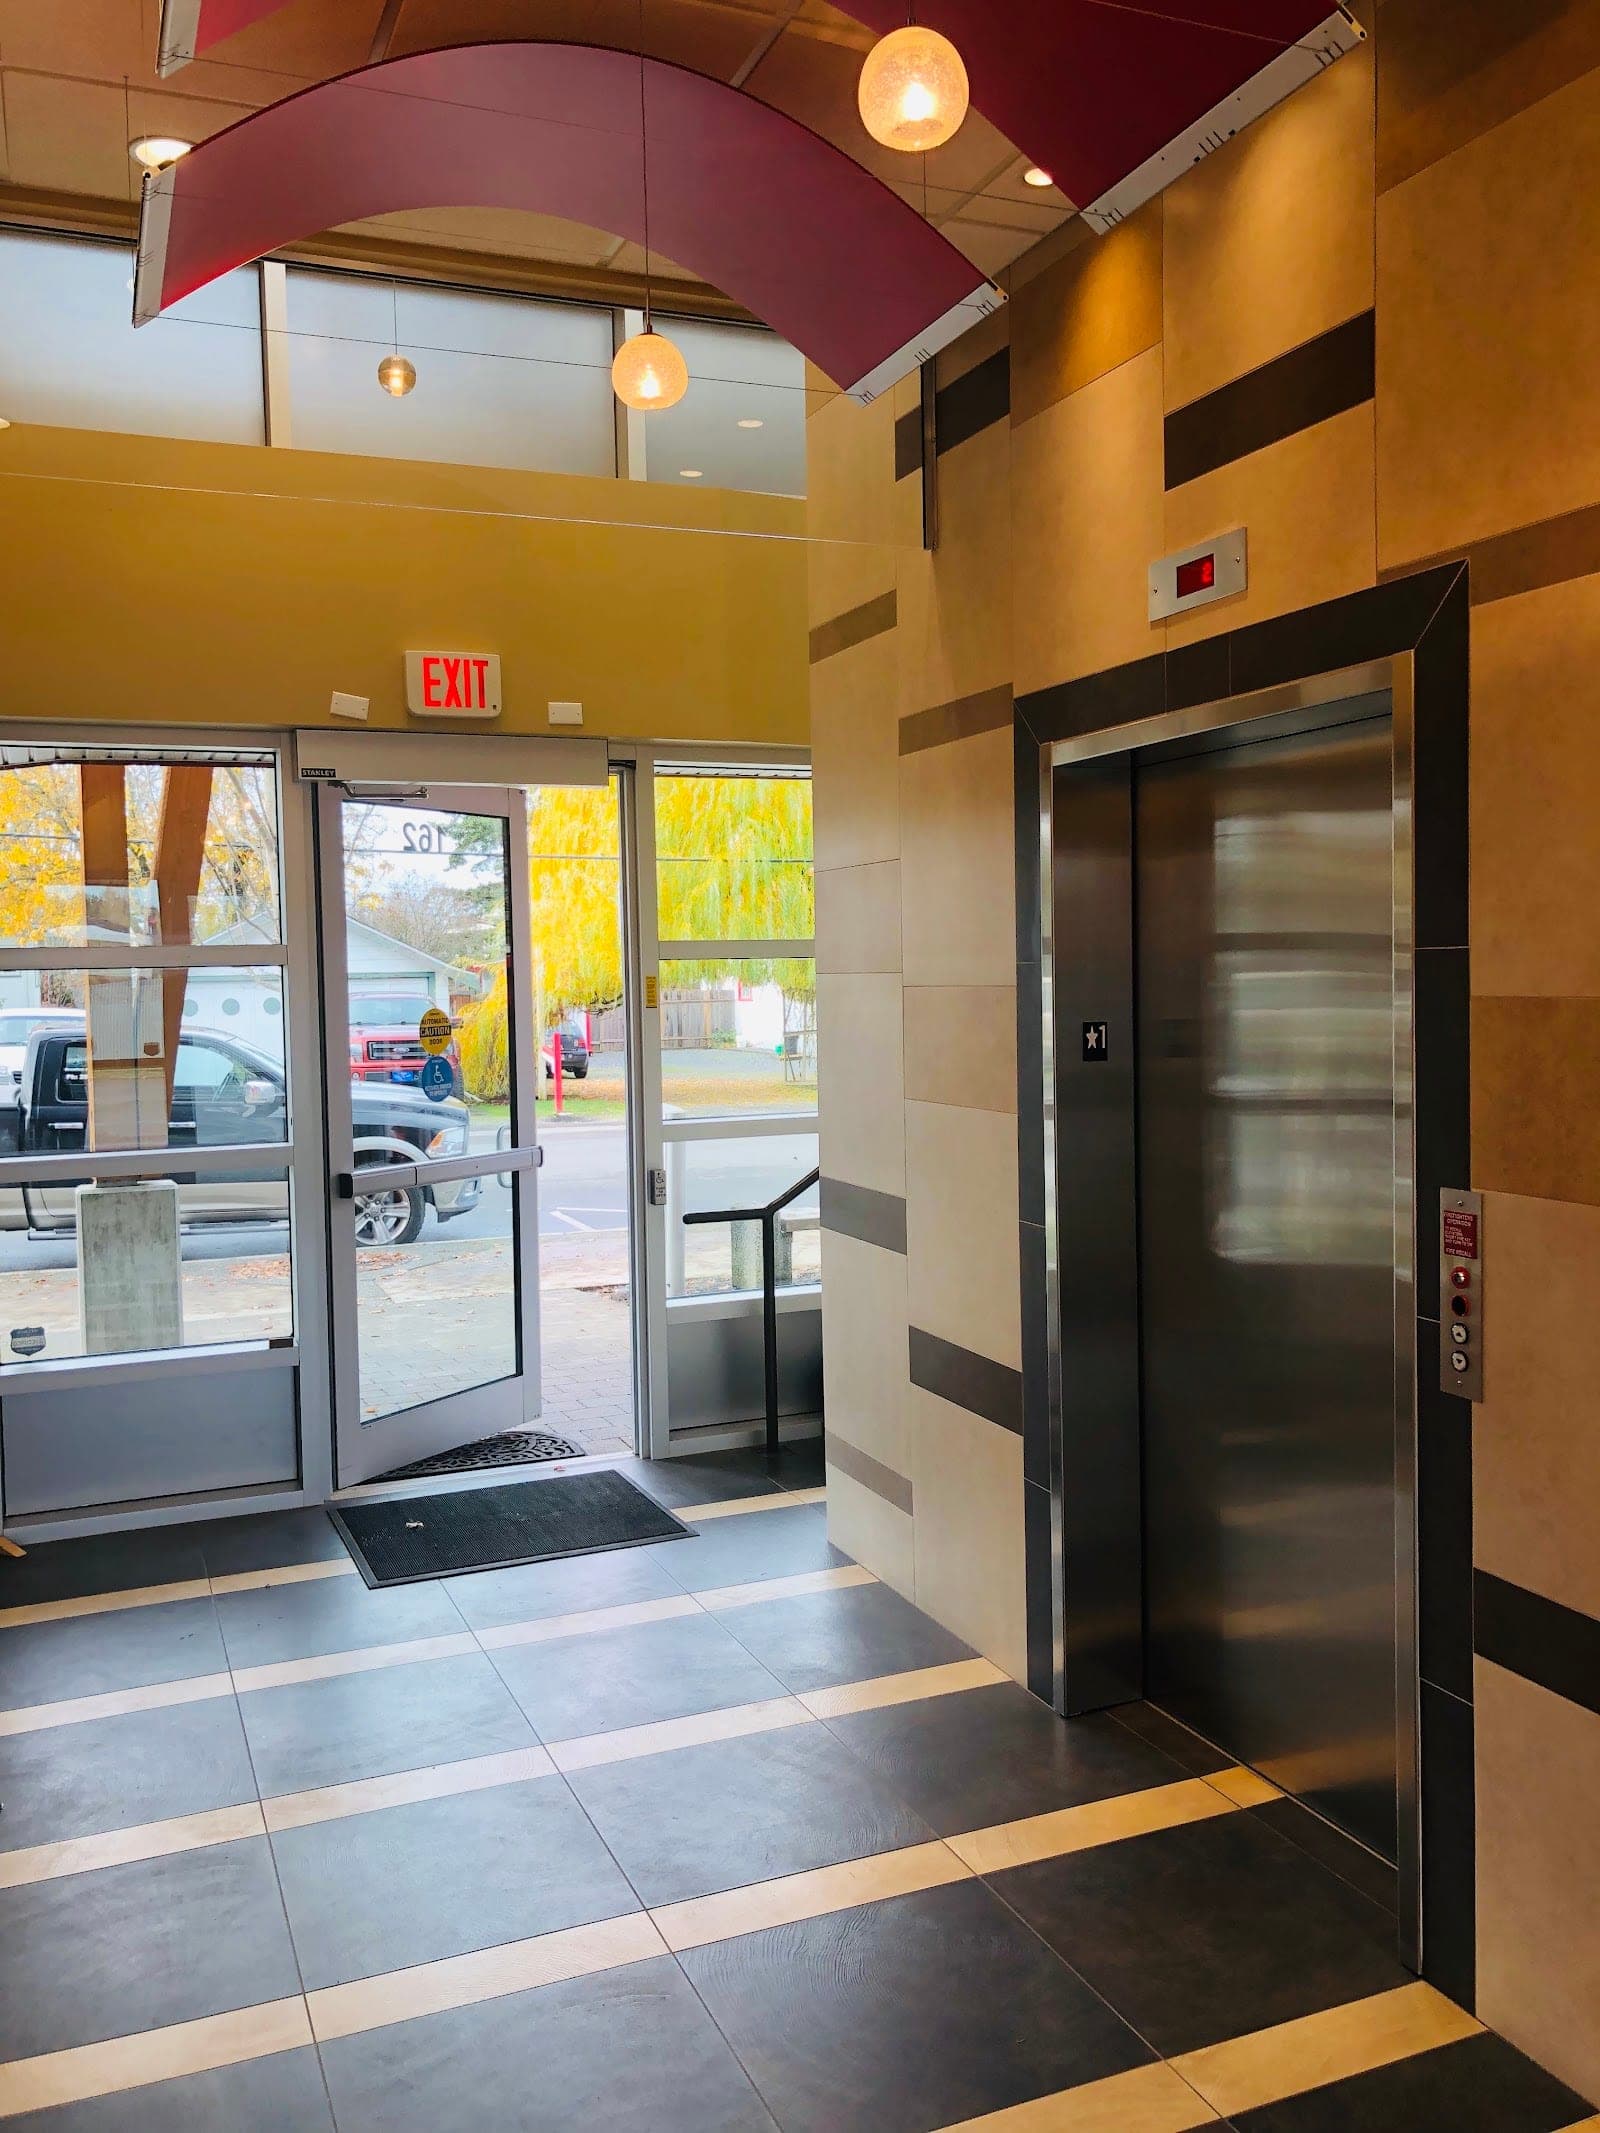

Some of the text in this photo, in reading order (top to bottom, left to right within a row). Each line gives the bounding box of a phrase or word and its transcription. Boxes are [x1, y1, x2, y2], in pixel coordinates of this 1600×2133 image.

[423, 657, 488, 708] EXIT
[302, 769, 335, 777] STANLEY
[421, 1025, 450, 1036] CAUTION
[1098, 1025, 1106, 1049] 1
